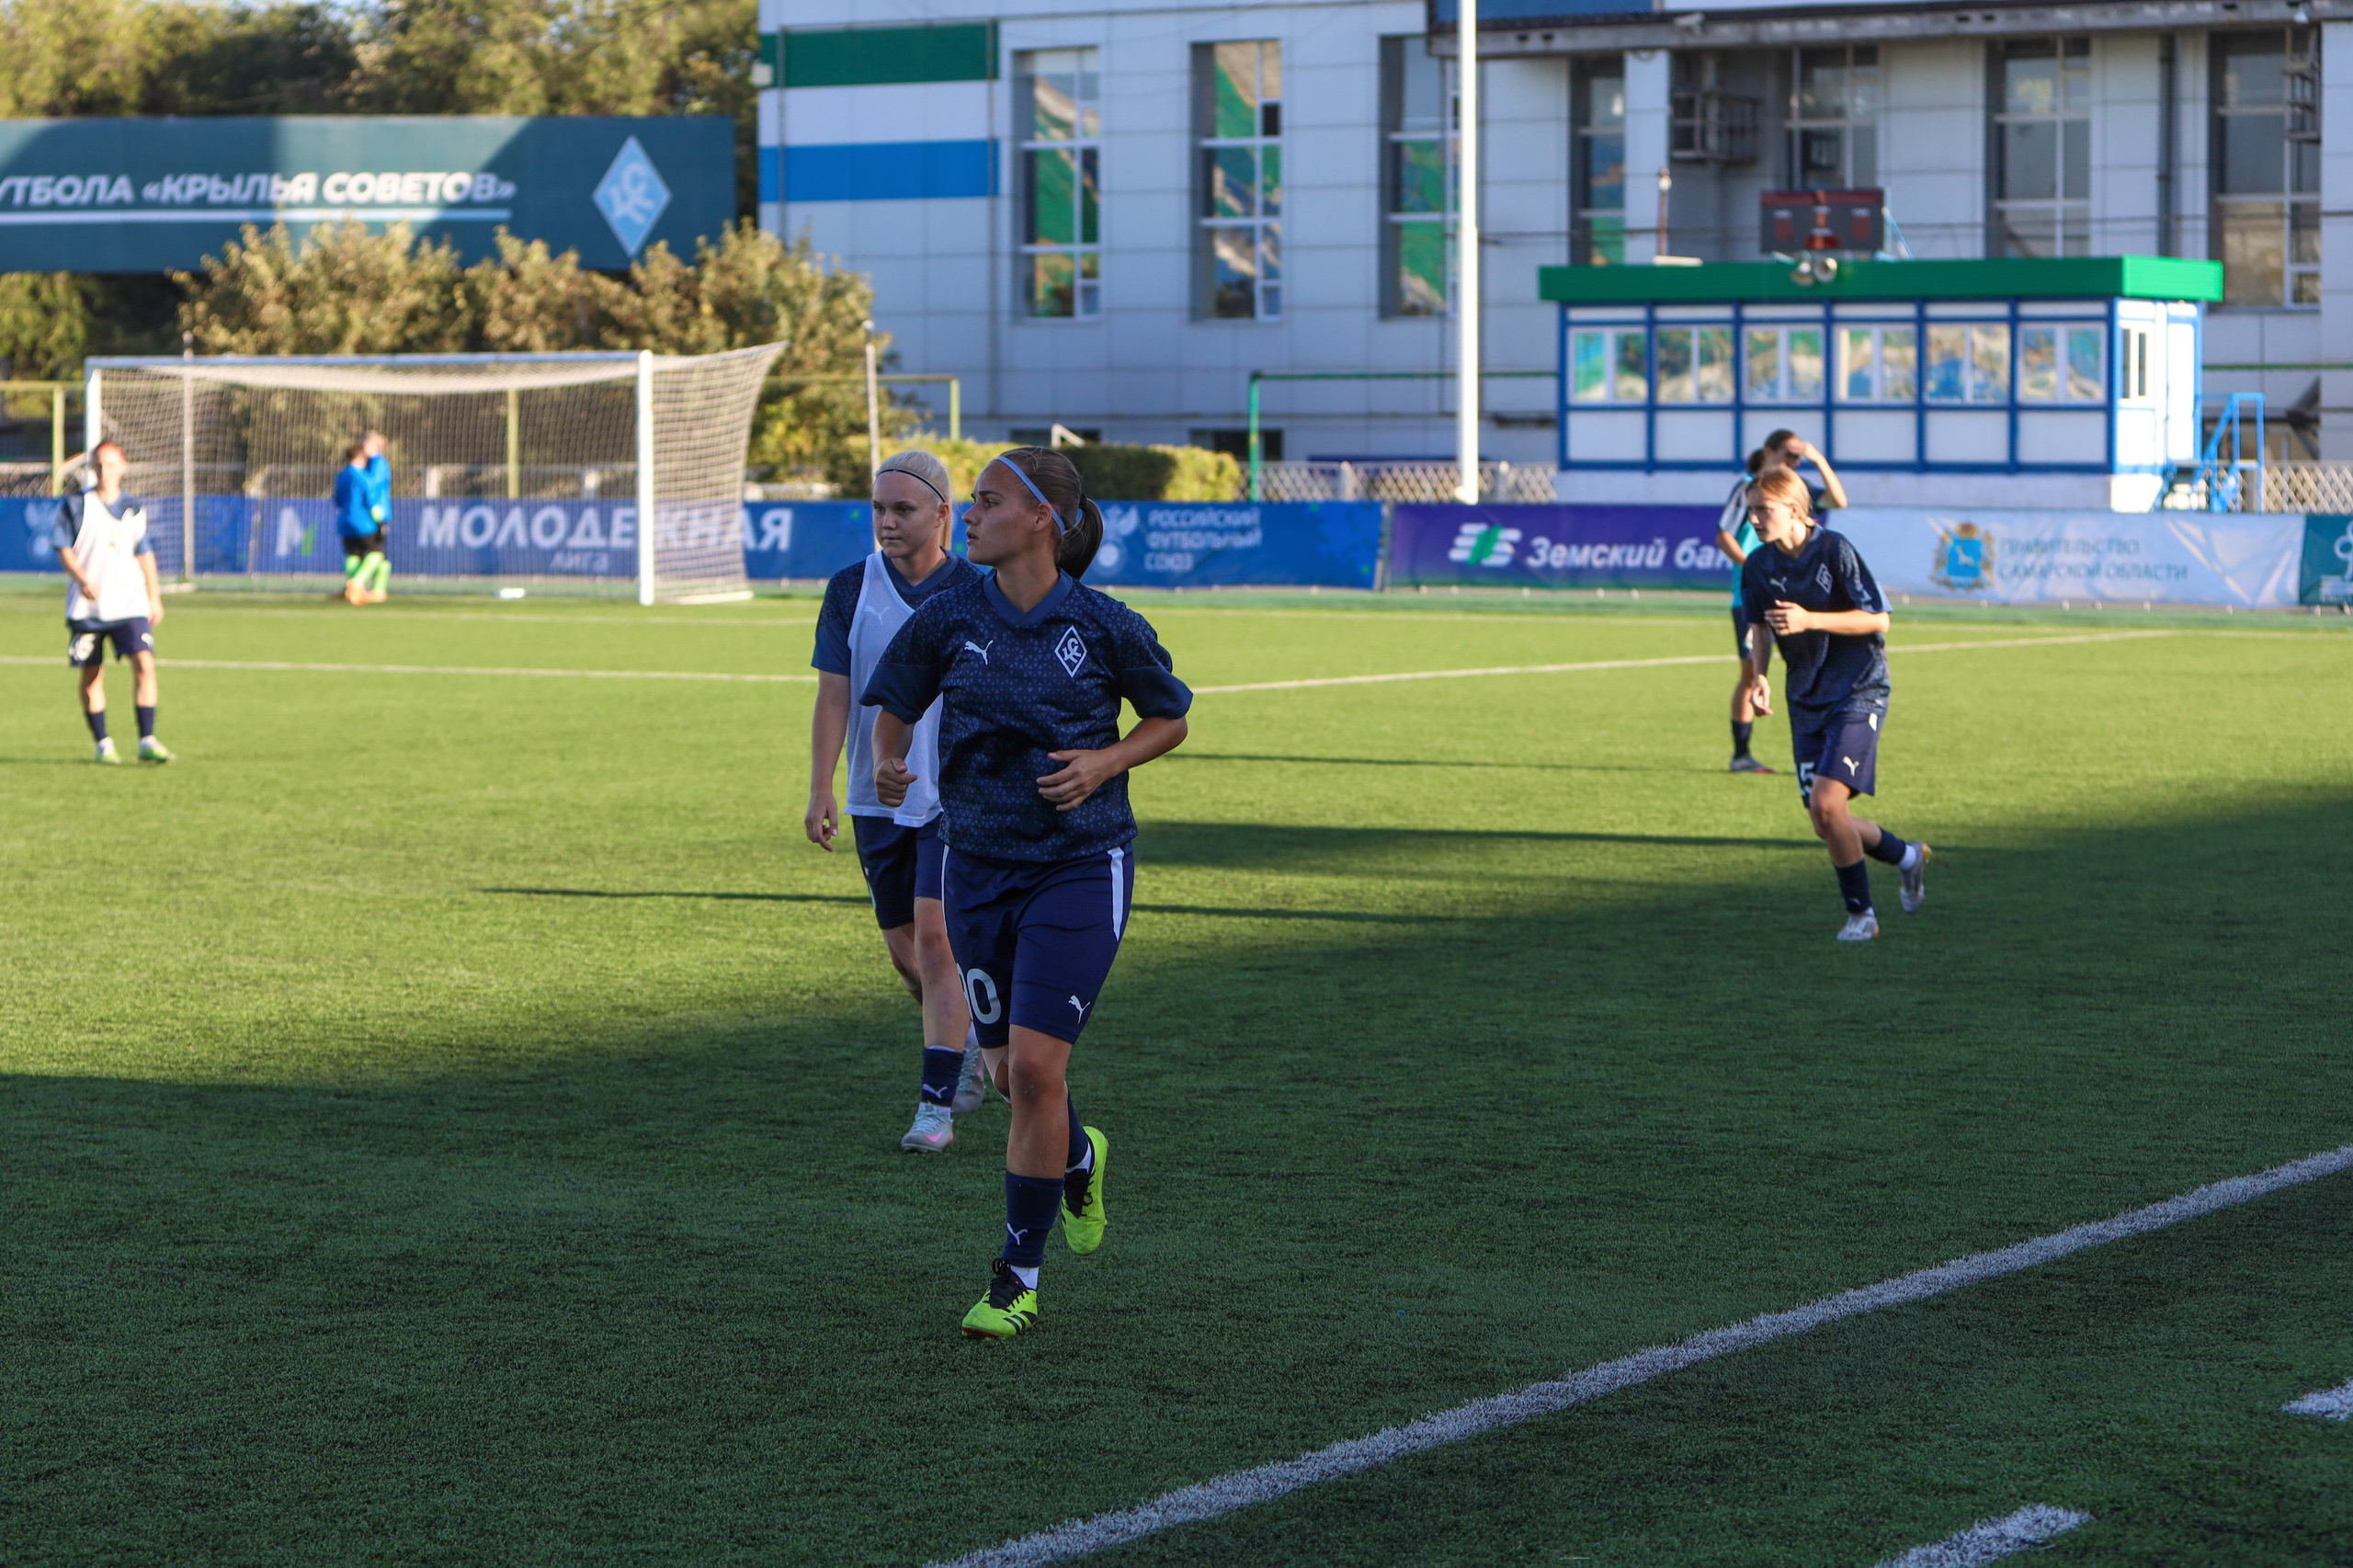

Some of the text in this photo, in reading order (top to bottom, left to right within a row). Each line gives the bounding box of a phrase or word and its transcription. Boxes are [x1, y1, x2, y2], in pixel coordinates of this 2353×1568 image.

[141, 172, 318, 204] «КРЫЛЬЯ
[323, 171, 516, 203] СОВЕТОВ»
[1526, 535, 1734, 569] Земский бан
